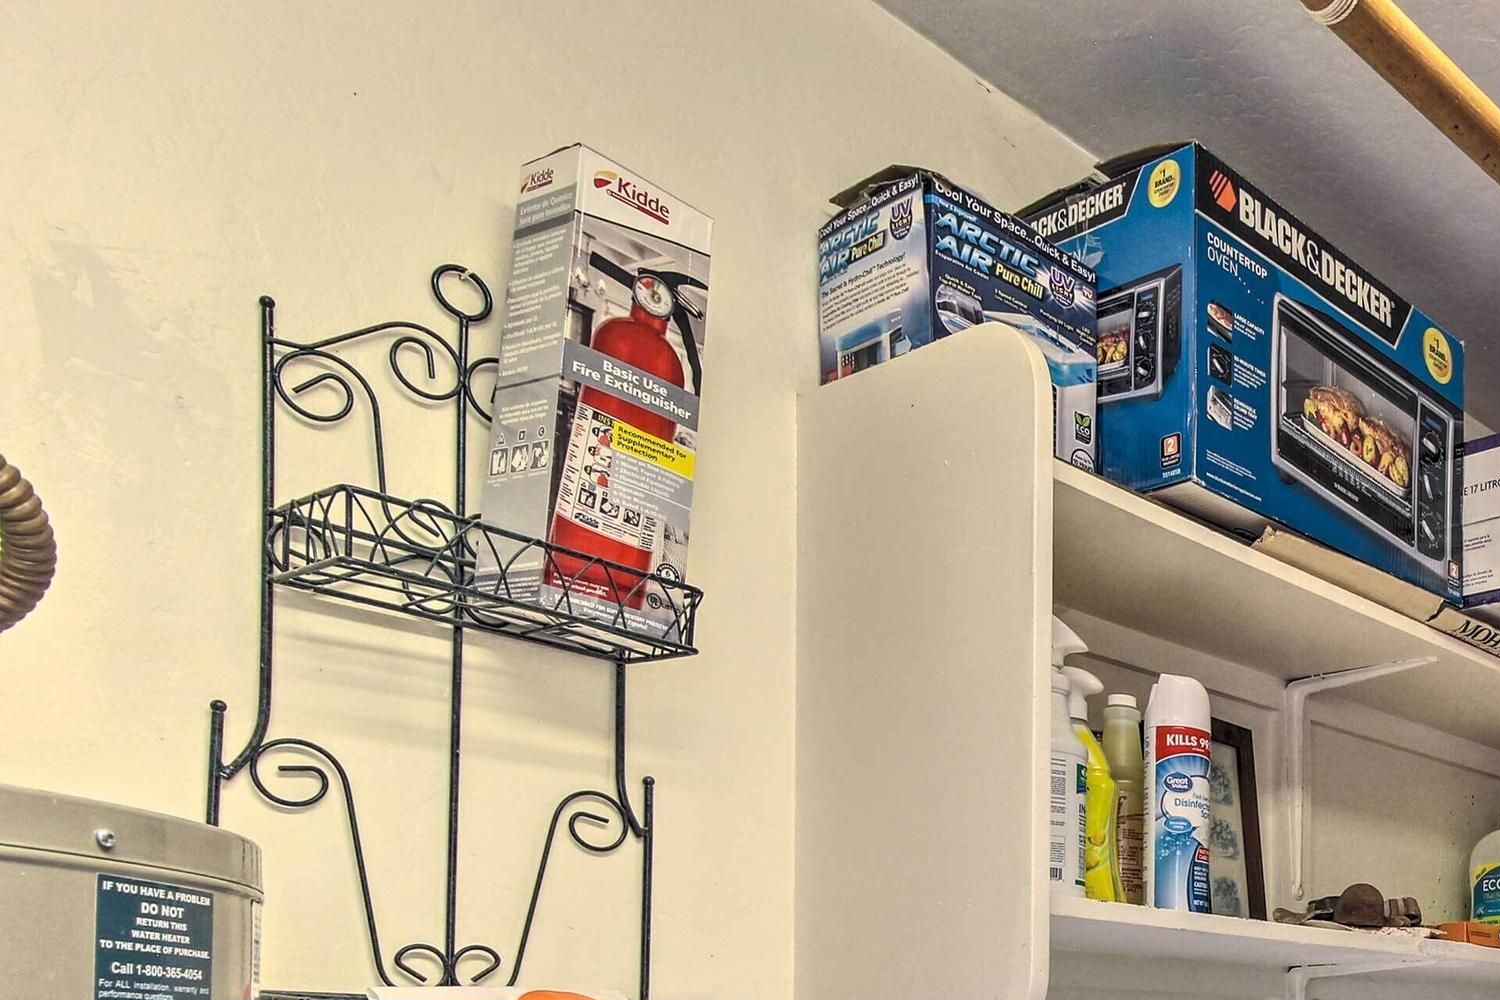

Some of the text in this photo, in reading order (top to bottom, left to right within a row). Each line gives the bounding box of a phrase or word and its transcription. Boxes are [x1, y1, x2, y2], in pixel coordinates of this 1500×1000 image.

[530, 168, 554, 186] Kidde
[891, 185, 898, 194] &
[898, 173, 919, 192] Easy!
[617, 176, 670, 218] Kidde
[891, 193, 914, 221] UV
[891, 215, 912, 229] LIGHT
[1030, 183, 1124, 238] ACK&DECKER
[820, 210, 880, 257] ARCTIC
[935, 212, 1039, 276] ARCTIC
[965, 194, 992, 218] Your
[1061, 256, 1070, 267] &
[1071, 258, 1096, 283] Easy!
[820, 249, 850, 282] AIR
[851, 242, 867, 261] Pure
[867, 231, 885, 252] Chill
[935, 234, 1044, 299] AIR Pure Chill
[1207, 231, 1268, 280] COUNTERTOP
[1207, 246, 1239, 277] OVEN
[1050, 265, 1075, 292] UV
[1051, 283, 1073, 298] LIGHT
[602, 359, 668, 397] Basic Use
[572, 360, 692, 420] Fire Extinguisher
[1076, 423, 1090, 436] ECO
[617, 433, 676, 462] Supplementary
[617, 441, 658, 461] Protection
[618, 425, 687, 459] Recommended for
[1470, 483, 1479, 494] 17
[1166, 733, 1198, 747] KILLS
[1166, 776, 1189, 785] Great
[102, 880, 211, 906] IF YOU HAVE A PROBLEM
[141, 902, 185, 919] DO NOT
[136, 917, 188, 931] RETURN THIS
[131, 929, 191, 944] WATER HEATER
[100, 939, 211, 959] TO THE PLACE OF PURCHASE.
[111, 961, 203, 981] Call 1-800-365-4054
[98, 978, 113, 988] For
[115, 979, 131, 989] ALL
[173, 985, 198, 996] warranty
[199, 986, 209, 995] and
[98, 989, 143, 1000] performance
